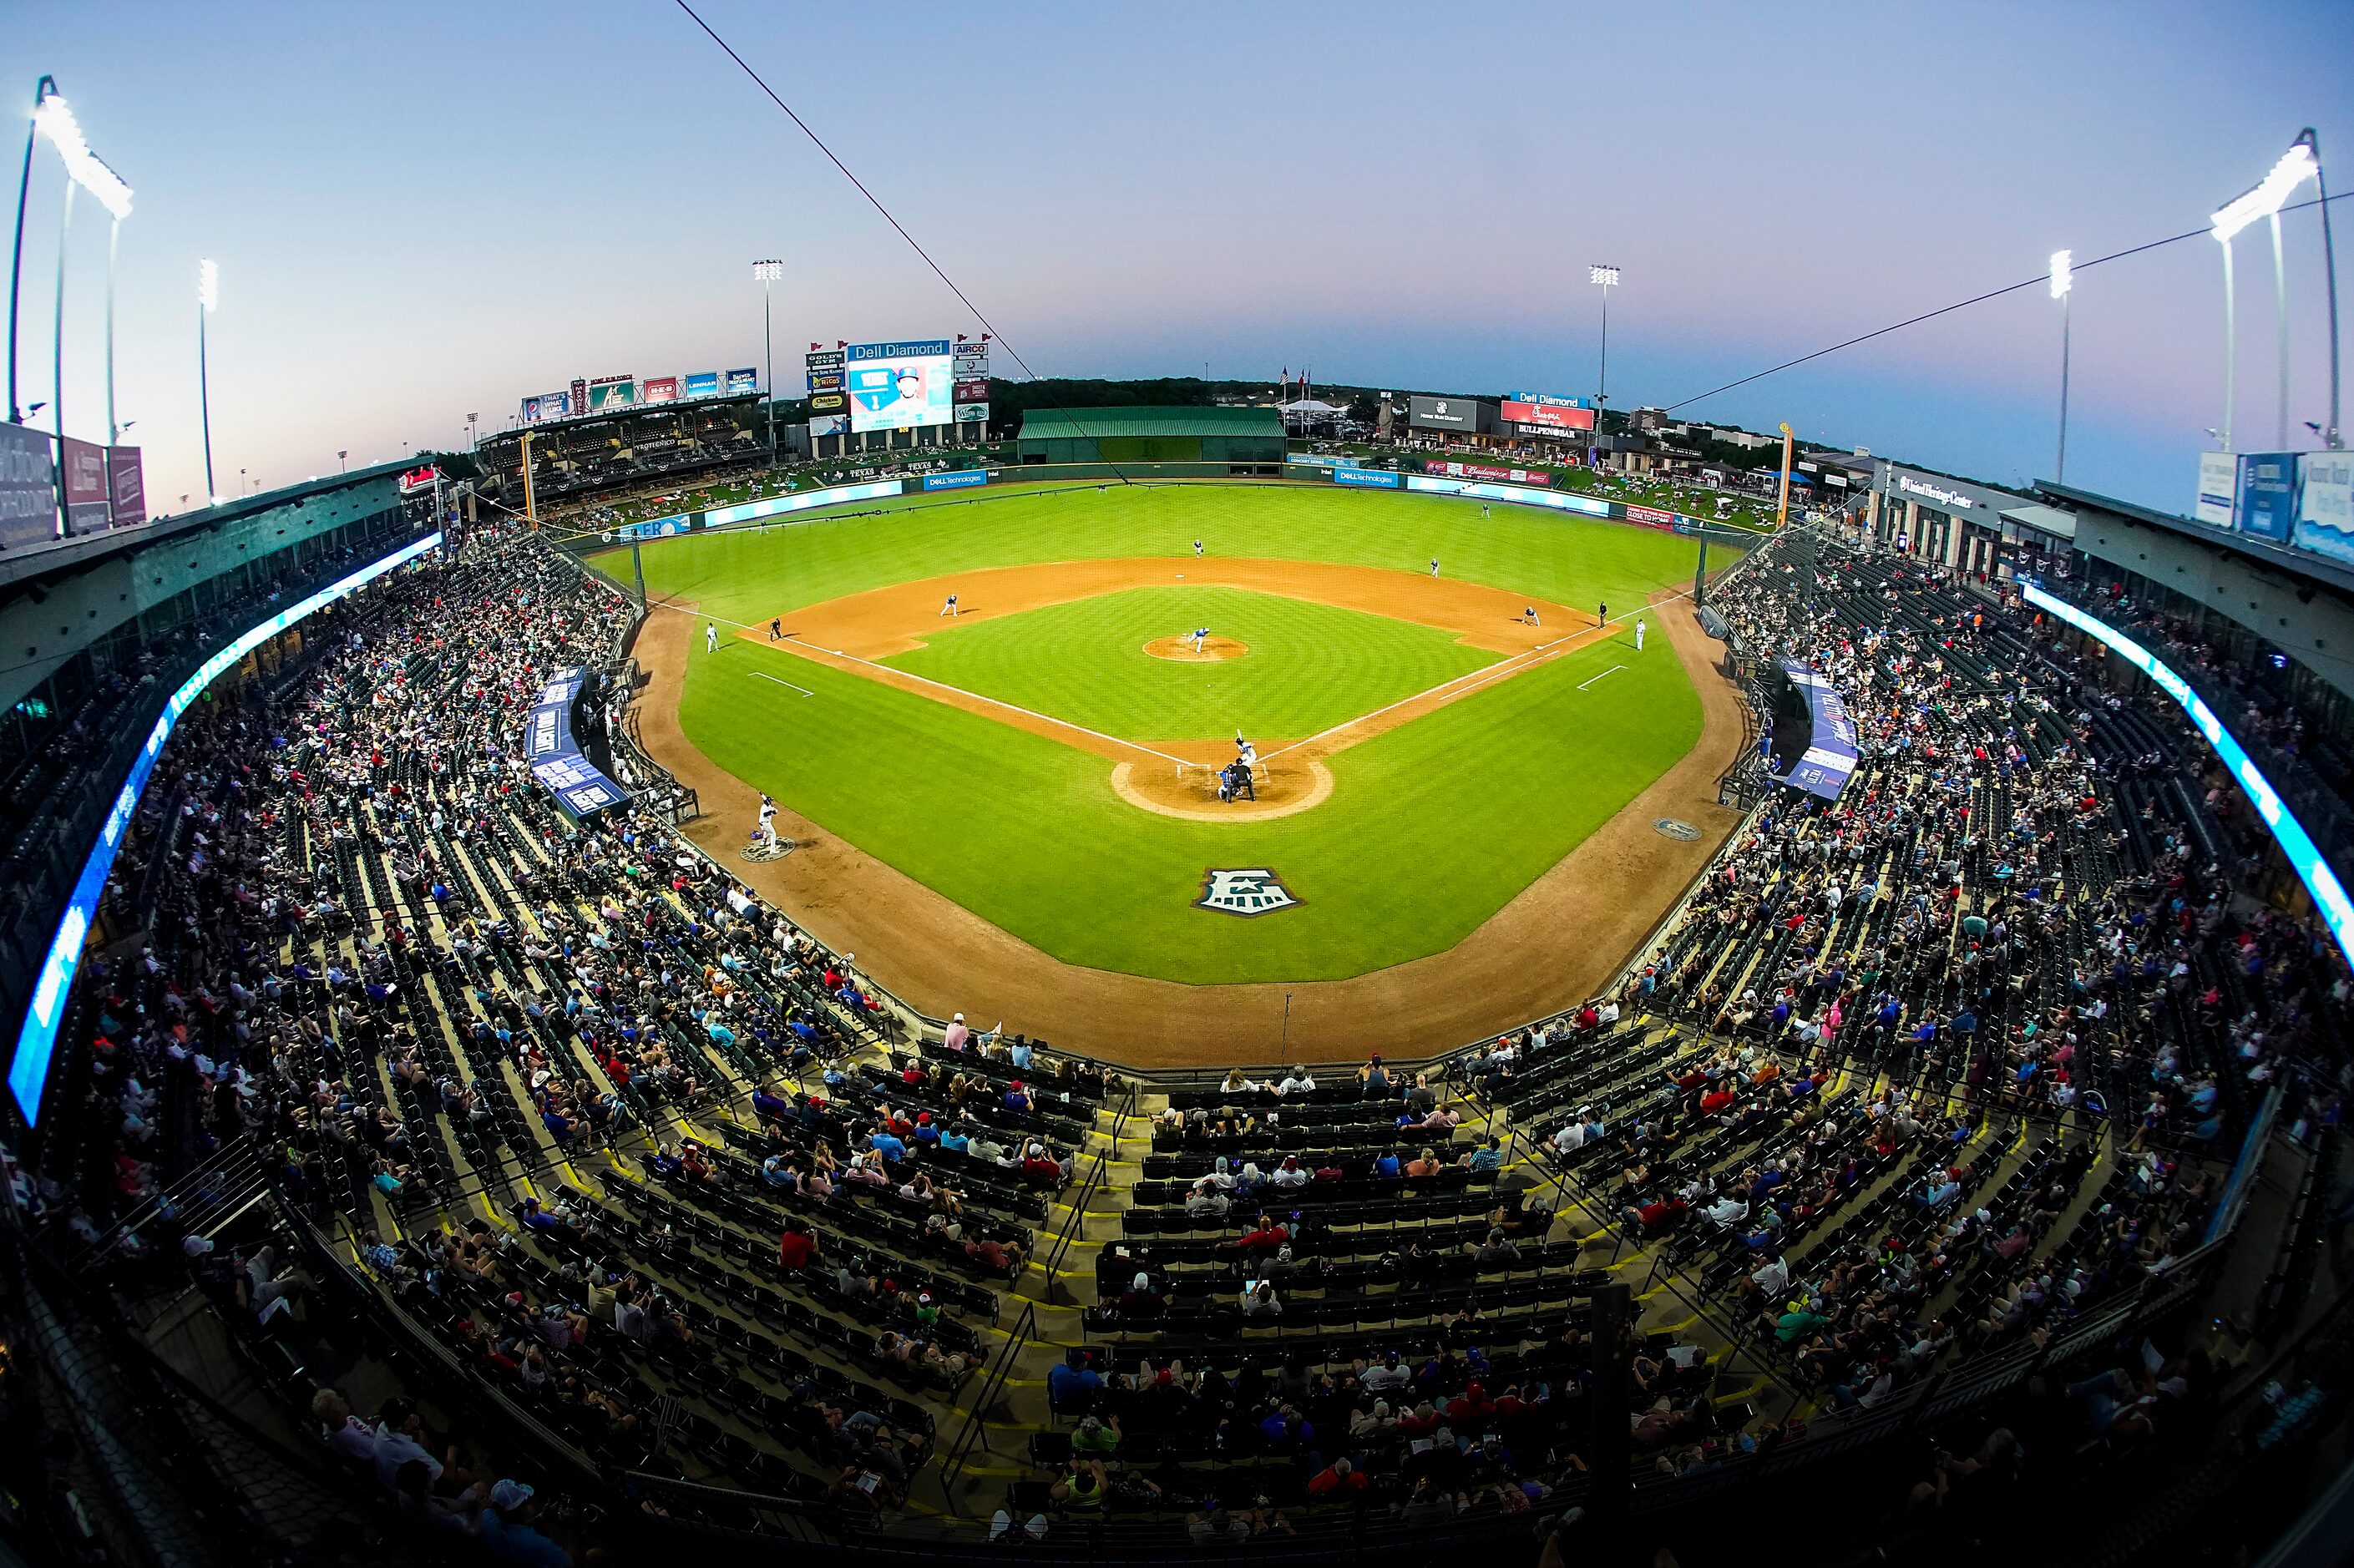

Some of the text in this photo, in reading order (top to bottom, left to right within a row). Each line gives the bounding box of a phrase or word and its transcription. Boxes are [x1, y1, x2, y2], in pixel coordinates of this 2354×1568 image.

[856, 341, 943, 359] Dell Diamond
[688, 381, 716, 389] LENNAR
[544, 392, 566, 402] THAT'S
[1520, 392, 1578, 407] Dell Diamond
[544, 400, 563, 408] WHAT
[1519, 425, 1576, 439] BULLPEN BAR
[908, 462, 932, 471] TEXAS
[1466, 465, 1507, 478] Budweiser
[850, 468, 875, 478] TEXAS
[1340, 472, 1393, 484] DELL Technologies
[929, 475, 981, 486] DELL Technologies
[1907, 478, 1973, 509] United Heritage Center
[1626, 510, 1643, 519] CLOSE
[1644, 513, 1652, 522] TO
